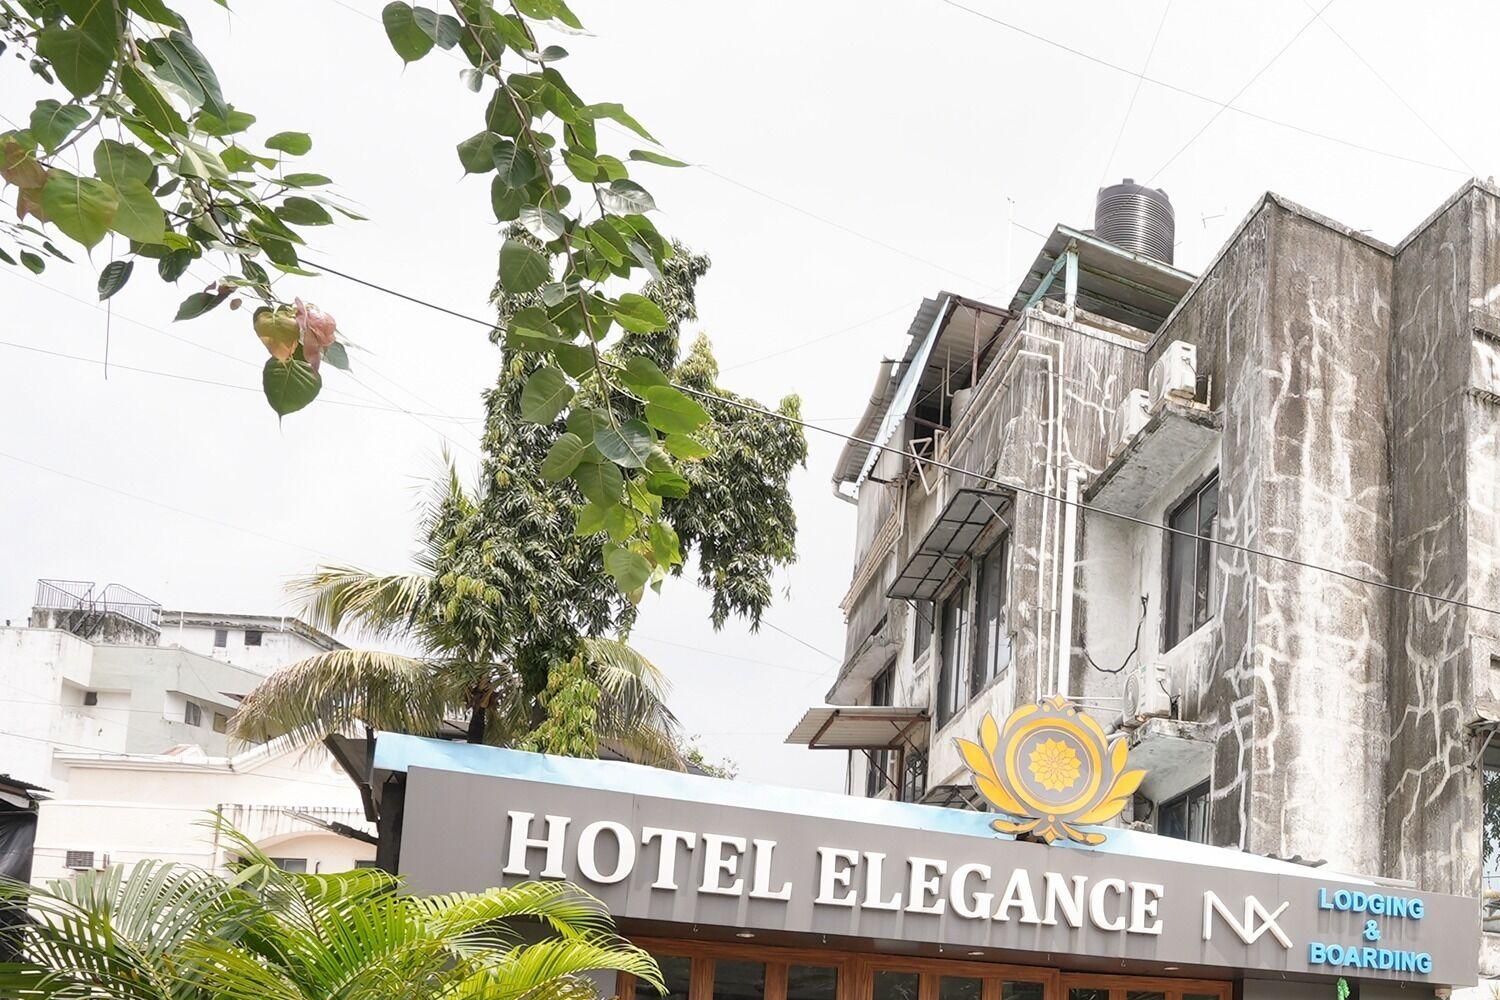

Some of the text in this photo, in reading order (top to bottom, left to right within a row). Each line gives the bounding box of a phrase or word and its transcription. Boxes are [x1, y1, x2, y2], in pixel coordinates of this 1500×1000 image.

[502, 810, 1293, 949] HOTEL ELEGANCE NX
[1319, 887, 1425, 919] LODGING
[1362, 919, 1381, 941] &
[1308, 942, 1433, 974] BOARDING
